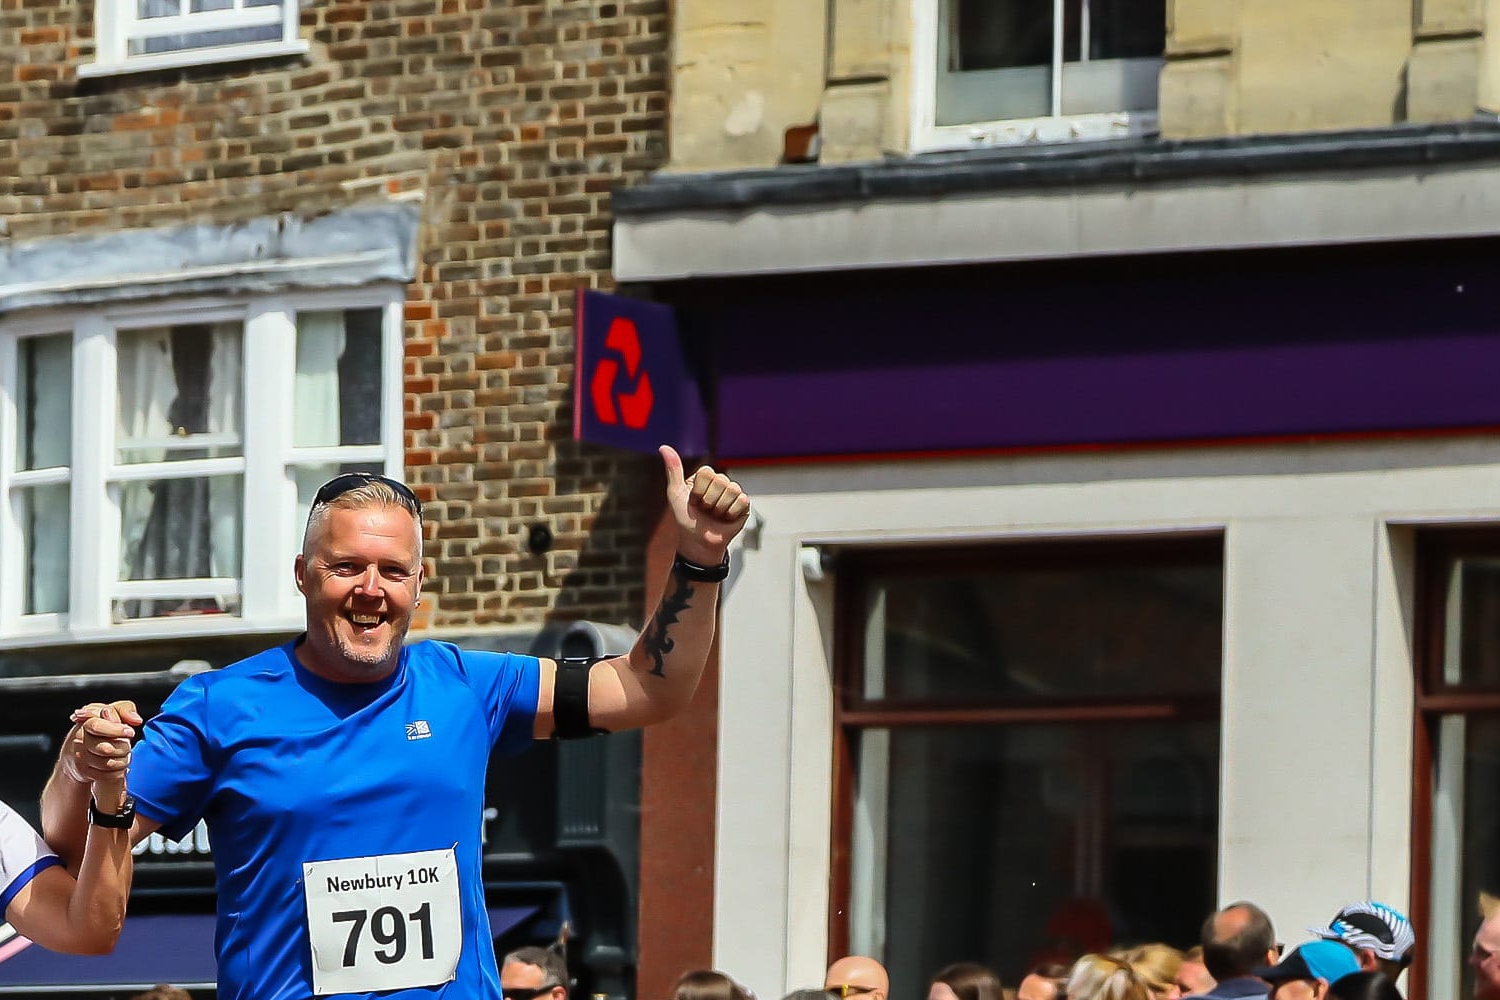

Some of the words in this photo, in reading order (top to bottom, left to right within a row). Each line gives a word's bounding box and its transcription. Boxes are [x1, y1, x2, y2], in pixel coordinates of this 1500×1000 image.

[326, 873, 403, 892] Newbury
[407, 867, 440, 885] 10K
[331, 902, 434, 968] 791
